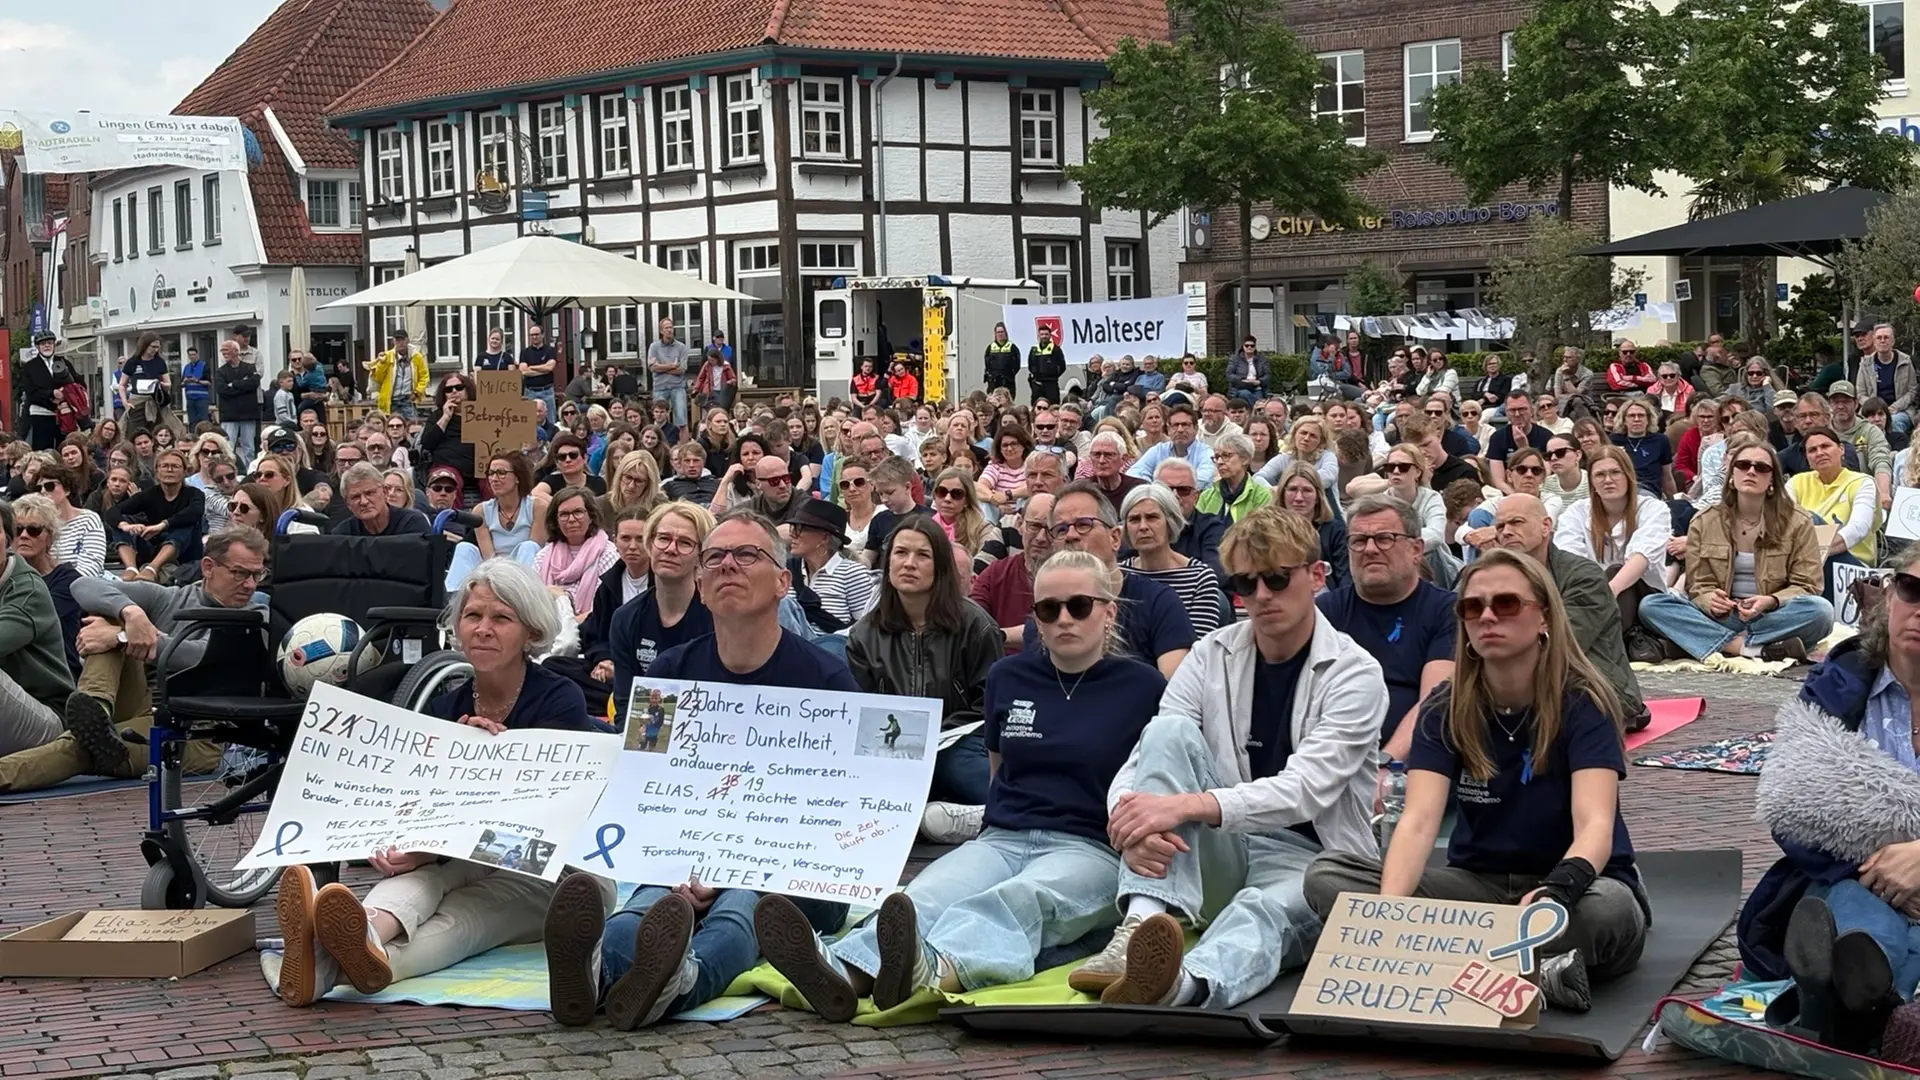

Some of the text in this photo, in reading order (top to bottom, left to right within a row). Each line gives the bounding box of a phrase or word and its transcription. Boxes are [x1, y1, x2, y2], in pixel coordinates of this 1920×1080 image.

[98, 120, 239, 133] Lingen (Ems) ist dabei!
[1391, 204, 1491, 229] Reisebüro
[1071, 315, 1164, 344] Malteser
[697, 690, 745, 715] Jahre
[755, 693, 791, 718] kein
[798, 698, 852, 725] Sport,
[359, 718, 440, 758] JAHRE
[691, 720, 737, 746] Jahre
[745, 726, 837, 756] Dunkelheit,
[300, 736, 331, 758] EIN
[336, 747, 396, 774] PLATZ
[408, 763, 439, 779] AM
[448, 766, 503, 781] TISCH
[515, 769, 545, 782] IST
[669, 754, 756, 775] andauernde
[305, 772, 325, 785] Wir
[334, 781, 394, 795] wünschen
[429, 788, 449, 796] für
[744, 777, 764, 792] 19
[742, 792, 798, 805] möchte
[806, 796, 849, 808] wieder
[859, 797, 912, 813] Fußball
[326, 820, 389, 830] ME/CFS
[684, 807, 707, 816] und
[717, 808, 737, 819] Ski
[745, 811, 789, 824] fahren
[799, 815, 842, 827] können
[478, 820, 545, 838] Versorgung
[679, 829, 745, 844] ME/CFS
[834, 830, 853, 842] Die
[792, 857, 865, 881] Versorgung
[787, 879, 883, 902] DRINGEND!
[1347, 897, 1497, 930] FORSCHUNG
[1395, 933, 1485, 956] MEINEN
[1329, 953, 1435, 977] KLEINEN
[1315, 960, 1536, 1016] BRUDER ELIAS
